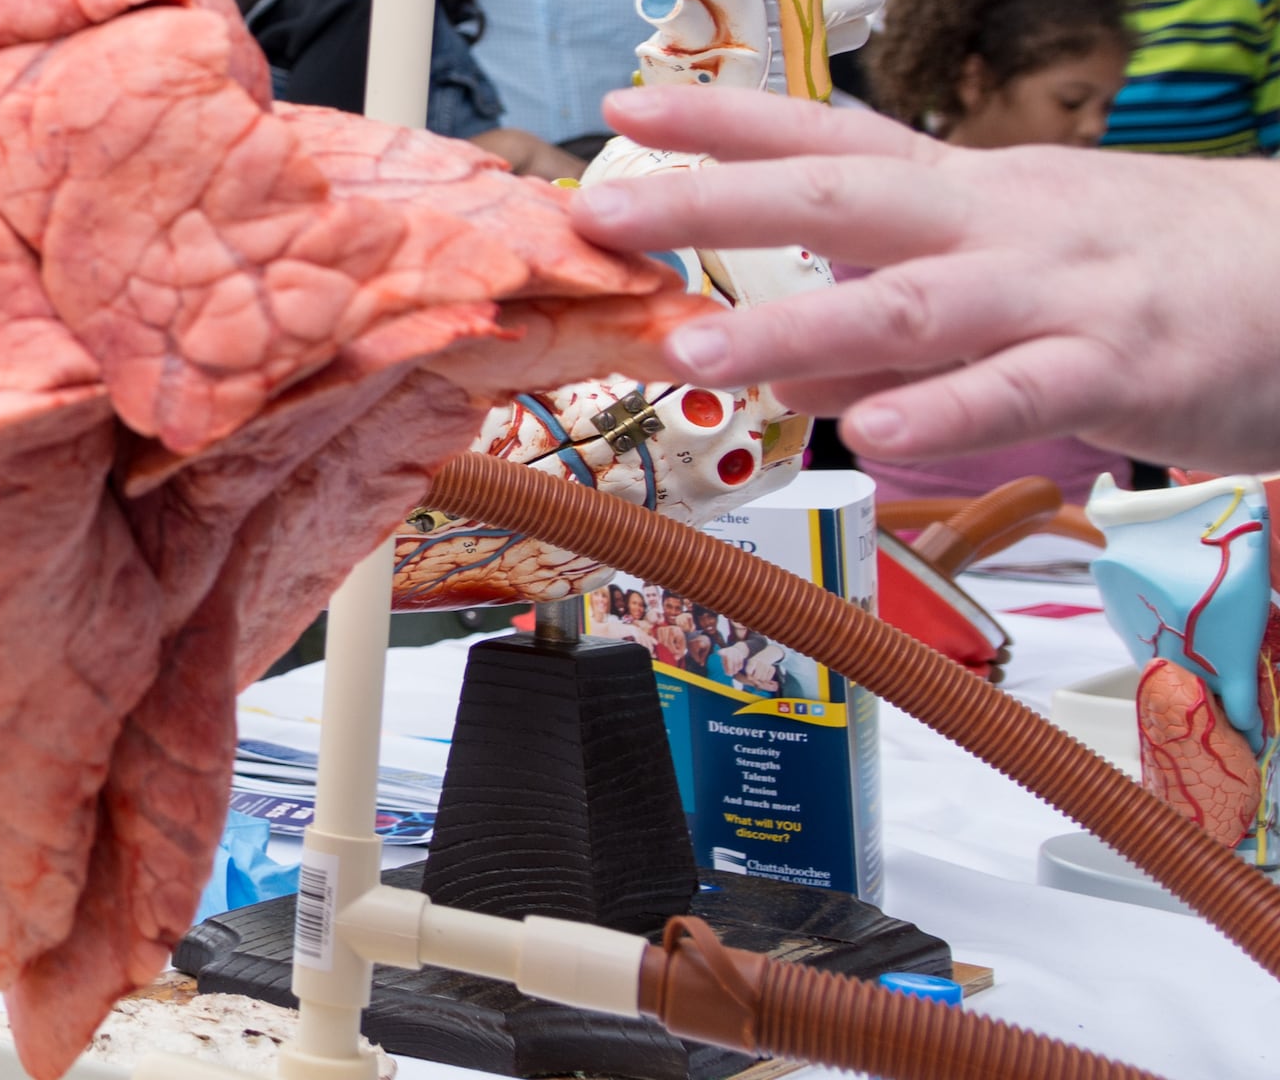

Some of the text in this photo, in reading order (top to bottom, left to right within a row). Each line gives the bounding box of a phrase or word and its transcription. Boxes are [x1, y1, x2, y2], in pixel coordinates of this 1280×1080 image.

[708, 720, 808, 742] Discover your:
[733, 743, 781, 759] Creativity
[735, 757, 781, 771] Strengths
[741, 771, 777, 783] Talents
[742, 784, 778, 796] Passion
[723, 795, 800, 812] And much more!
[723, 812, 802, 832] What will YOU
[735, 827, 791, 843] discover?
[746, 859, 831, 879] Chattahoochee
[792, 876, 832, 888] COLLEGE
